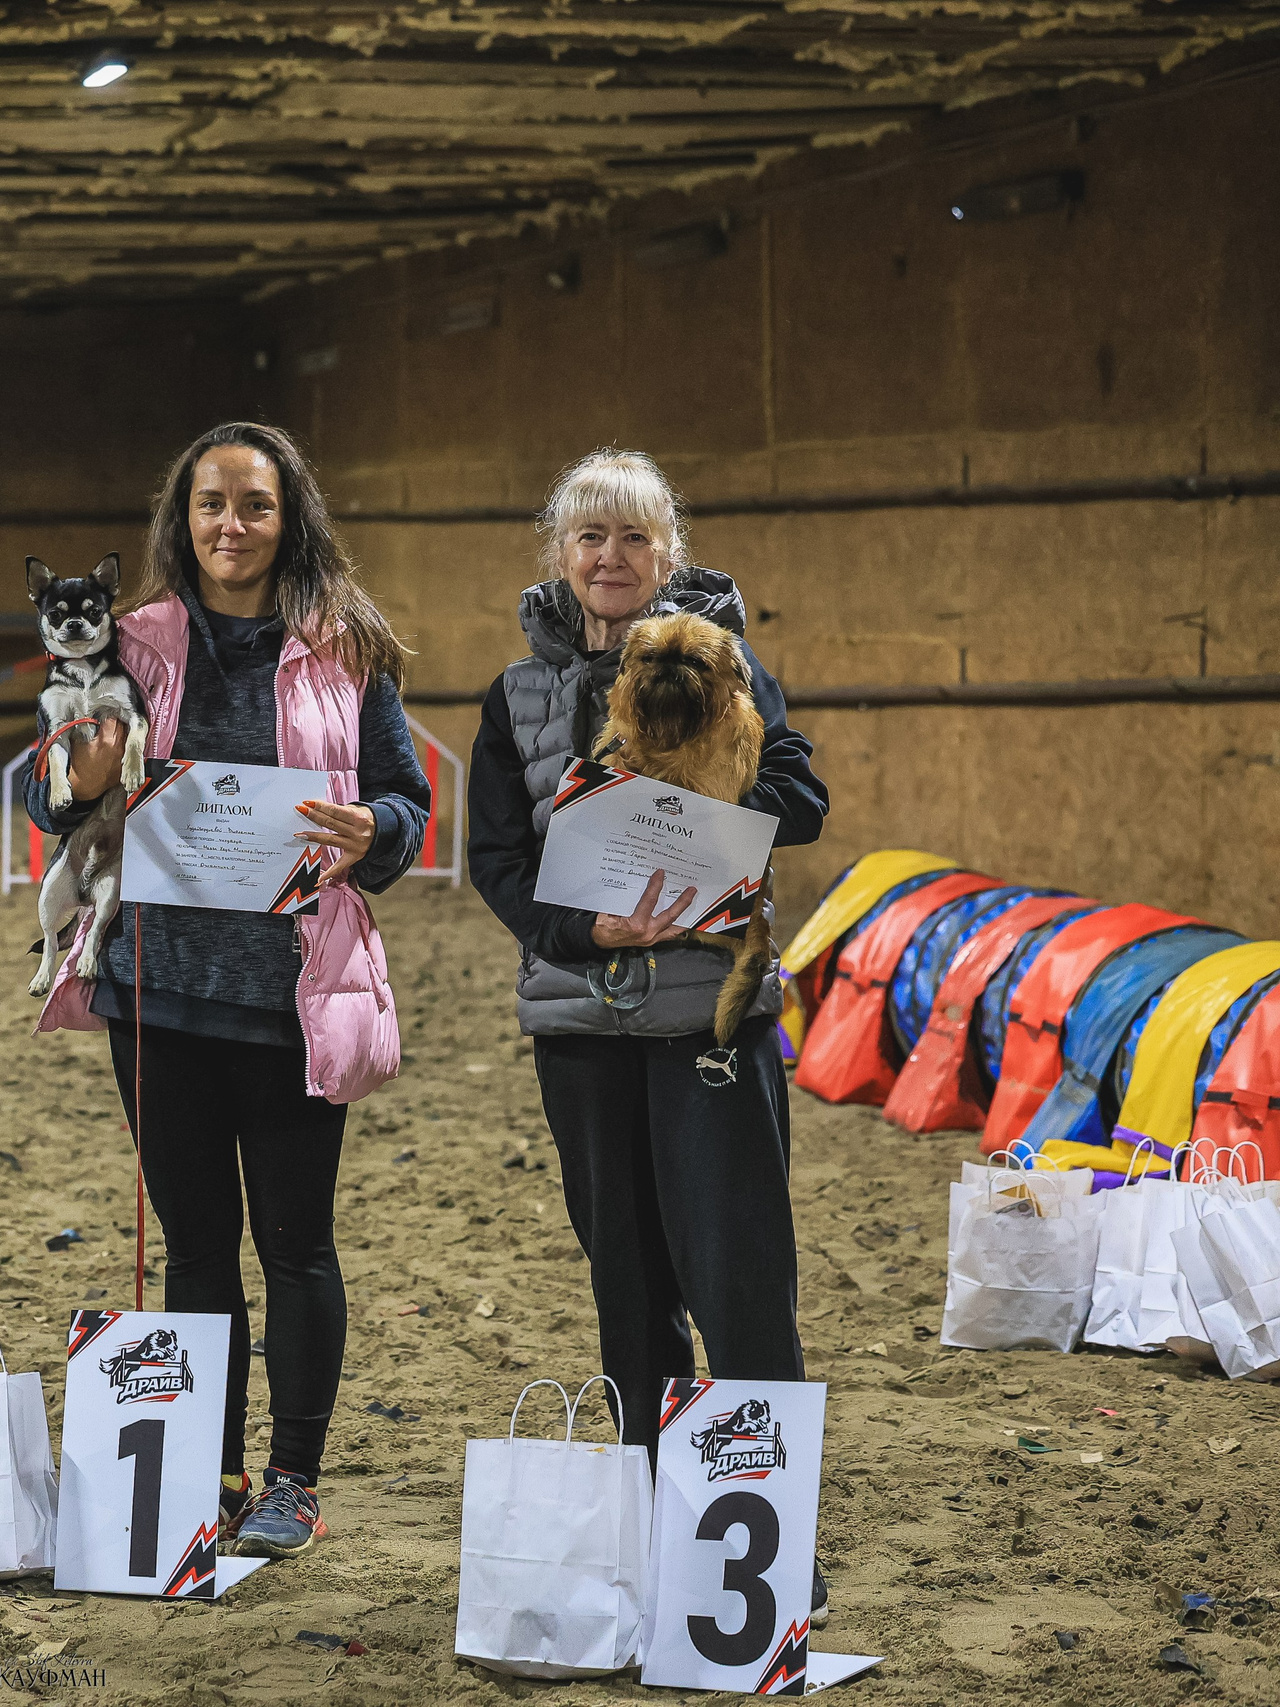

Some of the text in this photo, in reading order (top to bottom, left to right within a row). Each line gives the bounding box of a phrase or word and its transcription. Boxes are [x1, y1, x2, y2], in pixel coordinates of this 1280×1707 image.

[194, 802, 253, 816] ДИПЛОМ
[629, 812, 694, 839] ДИПЛОМ
[117, 1372, 185, 1404] ДРАЙВ
[707, 1446, 777, 1482] ДРАЙВ
[118, 1419, 166, 1578] 1
[687, 1491, 780, 1667] 3
